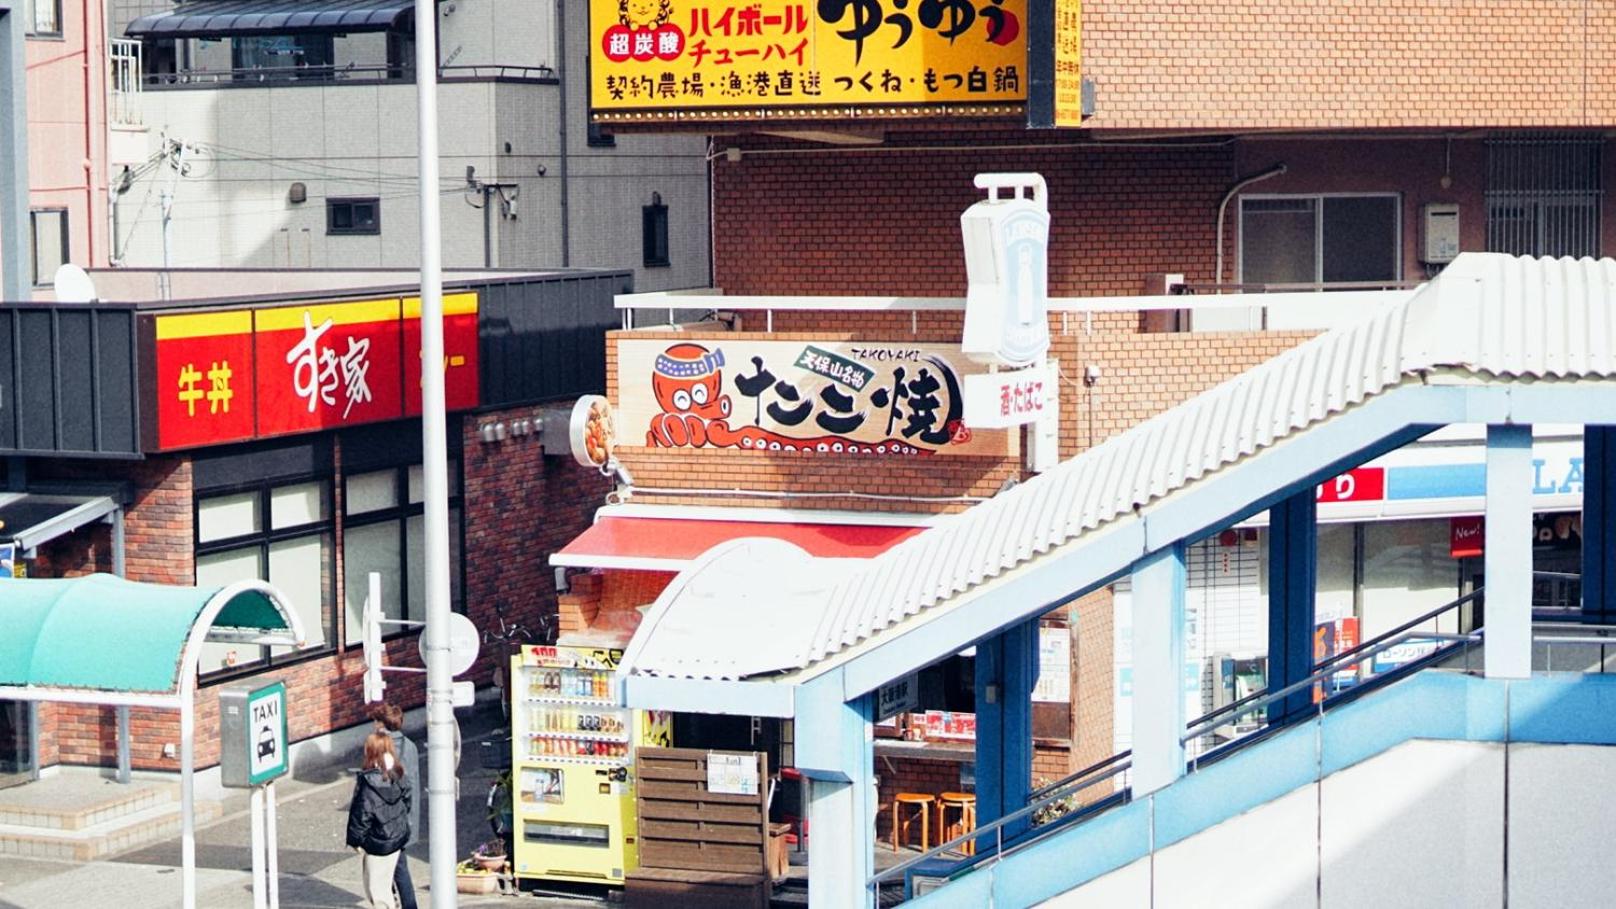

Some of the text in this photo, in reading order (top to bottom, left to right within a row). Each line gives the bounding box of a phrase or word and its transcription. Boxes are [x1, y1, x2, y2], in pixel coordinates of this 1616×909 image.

[688, 4, 809, 37] ハイボール
[817, 0, 1007, 67] ゆうゆう
[609, 32, 680, 55] 超炭酸
[688, 37, 809, 68] チューハイ
[606, 66, 1019, 100] 契約農場・漁港直送 つくね・もつ白鍋
[286, 310, 372, 420] すき家
[801, 351, 866, 389] 天保山名物
[851, 349, 921, 363] TAKOYAKI
[178, 360, 234, 417] 牛丼
[1532, 458, 1584, 494] LA
[253, 700, 278, 723] TAXI
